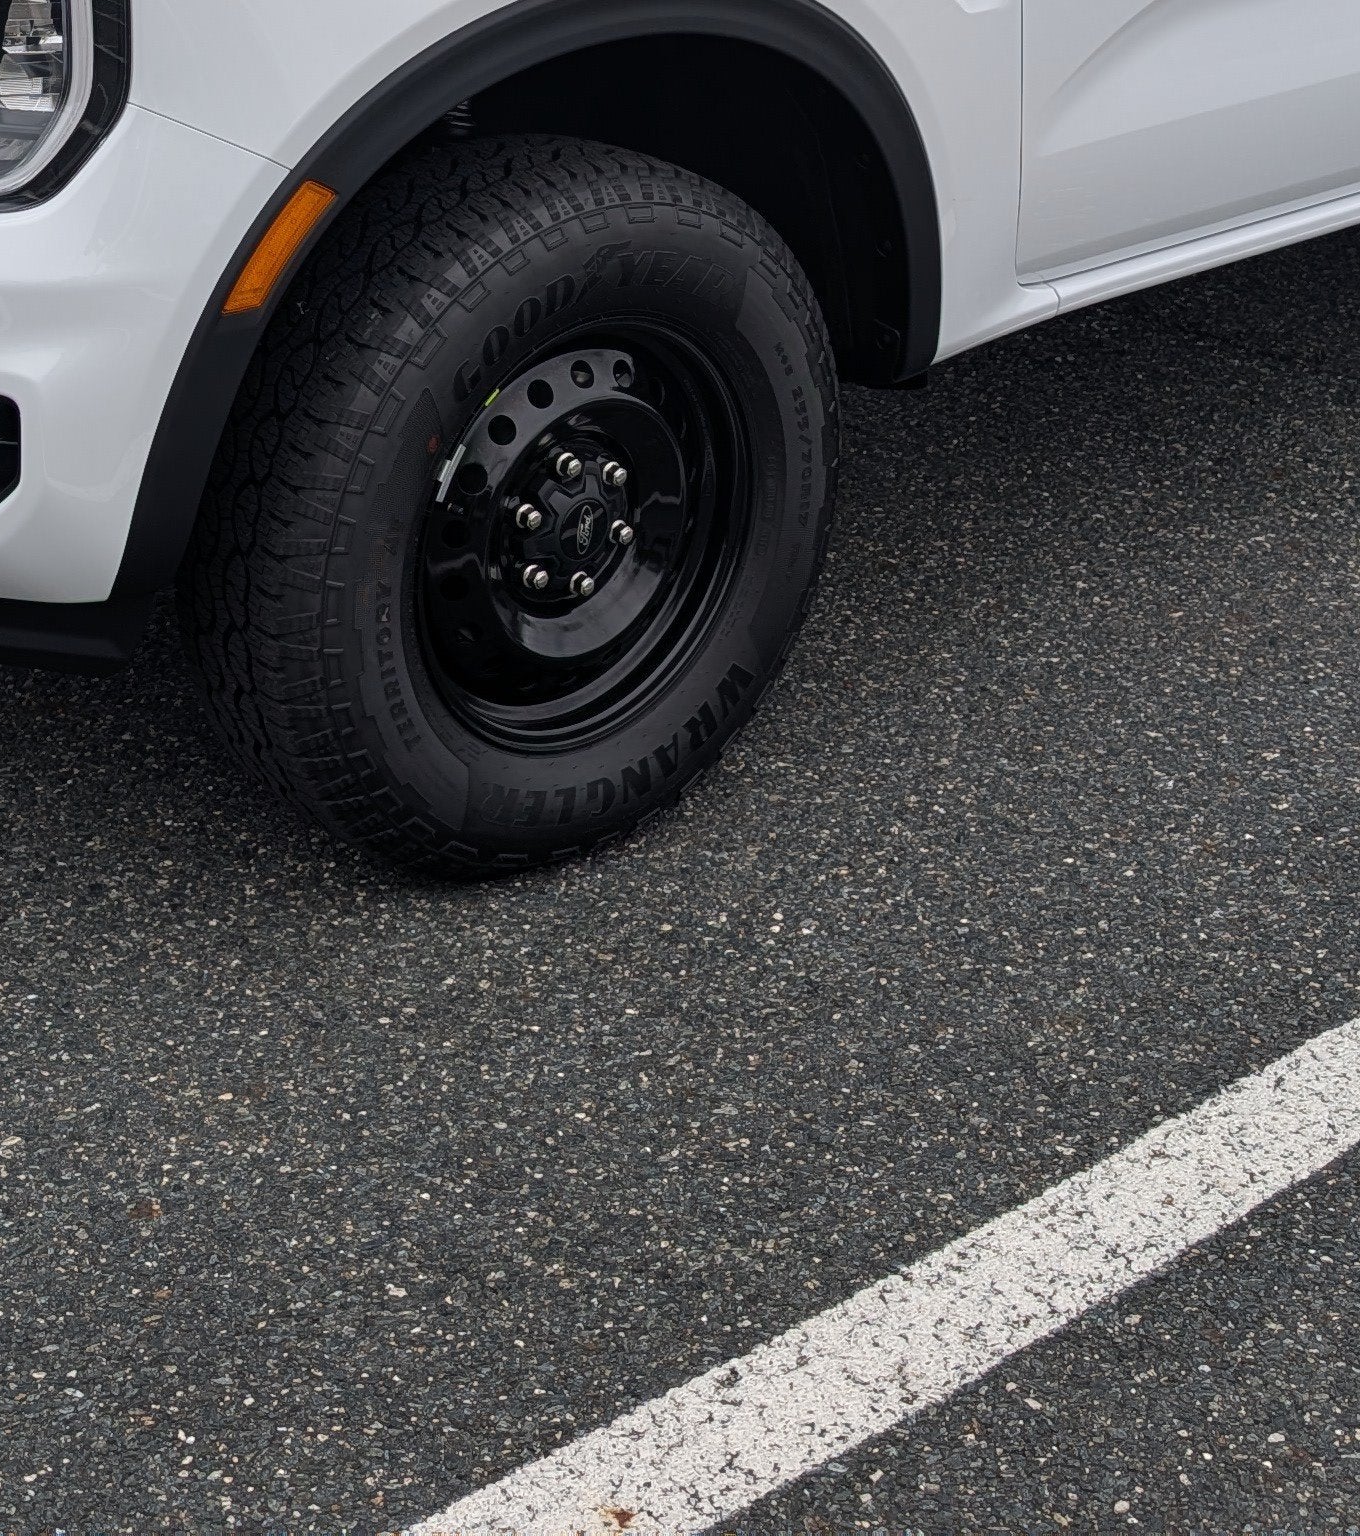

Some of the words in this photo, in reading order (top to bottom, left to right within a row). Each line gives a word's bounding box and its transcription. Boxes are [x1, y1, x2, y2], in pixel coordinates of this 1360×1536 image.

[452, 240, 736, 403] GOODYEAR
[375, 580, 423, 753] TERRITORY
[480, 661, 757, 828] WRANGLER
